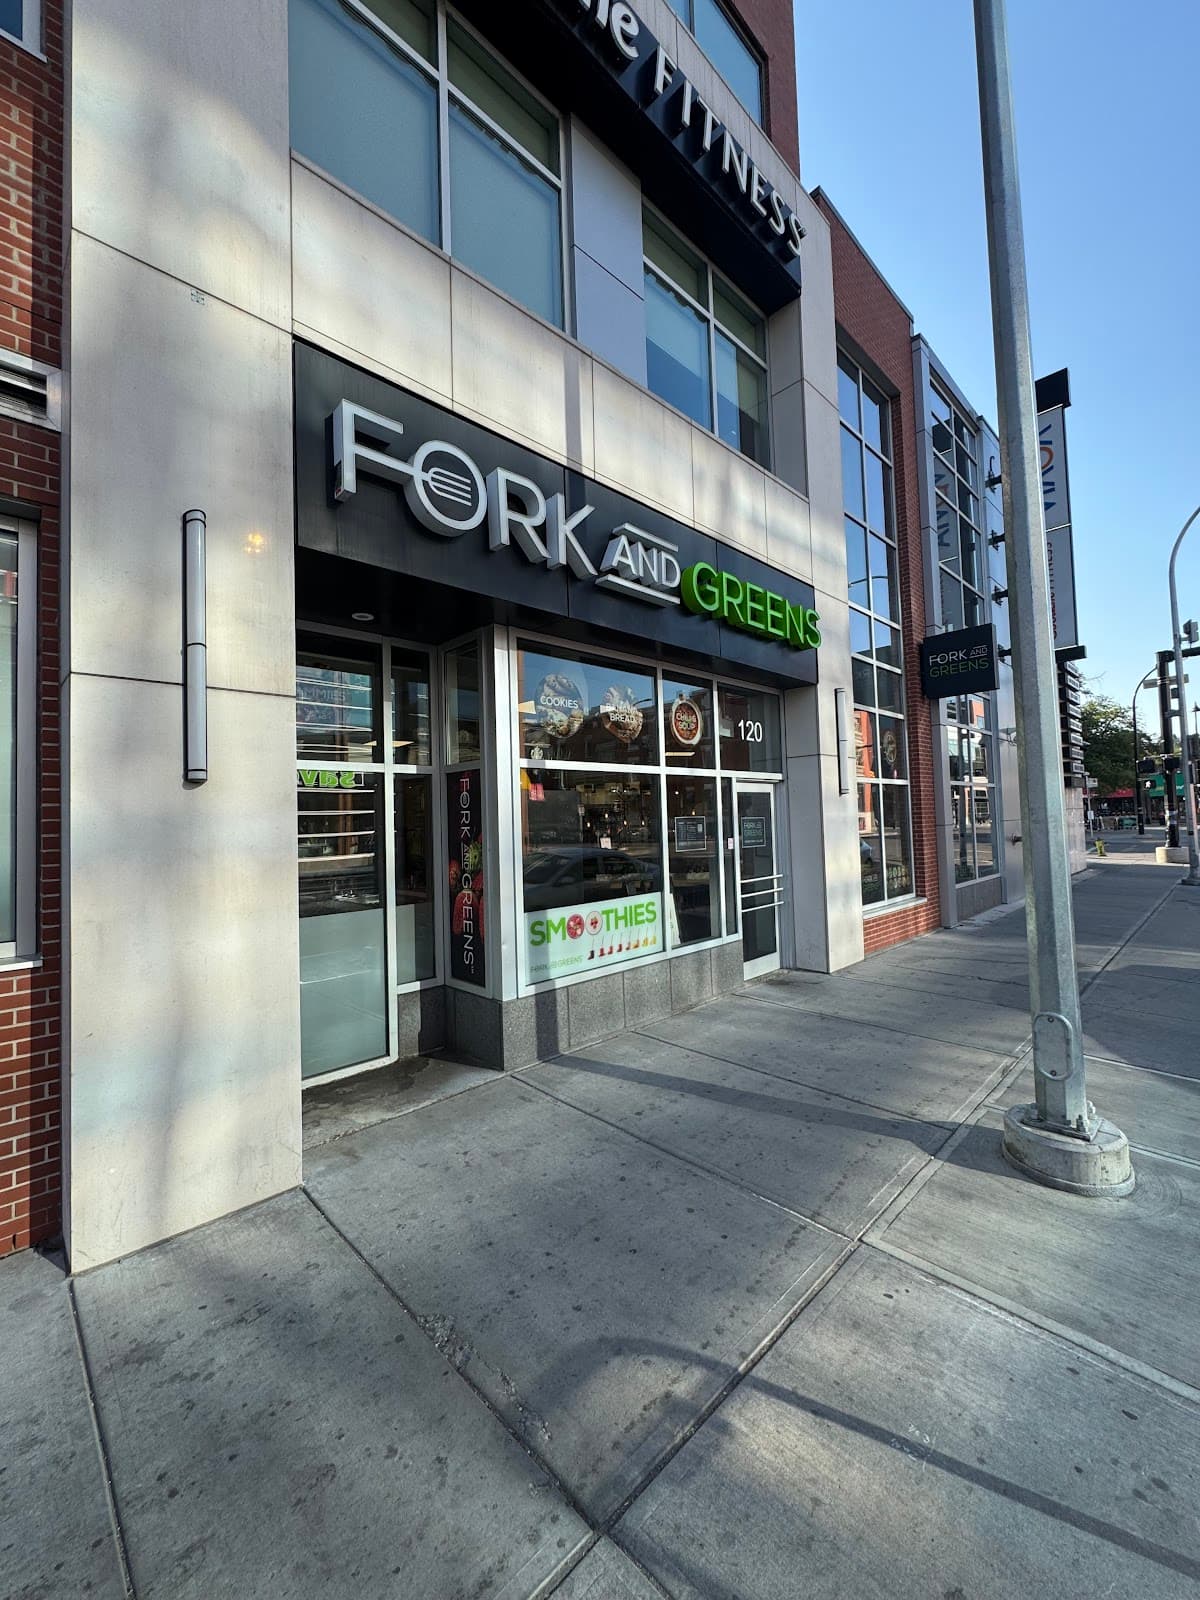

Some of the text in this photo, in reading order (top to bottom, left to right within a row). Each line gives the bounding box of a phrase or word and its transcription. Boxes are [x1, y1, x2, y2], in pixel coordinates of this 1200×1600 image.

[654, 45, 808, 257] FITNESS
[333, 399, 822, 649] FORK AND GREENS
[929, 647, 988, 666] FORK AND
[929, 658, 989, 678] GREENS
[540, 695, 579, 710] COOKIES
[610, 713, 636, 723] BREAD
[738, 719, 763, 743] 120
[459, 778, 471, 838] FORK
[461, 873, 474, 965] GREENS
[530, 901, 657, 946] SMOOTHIES
